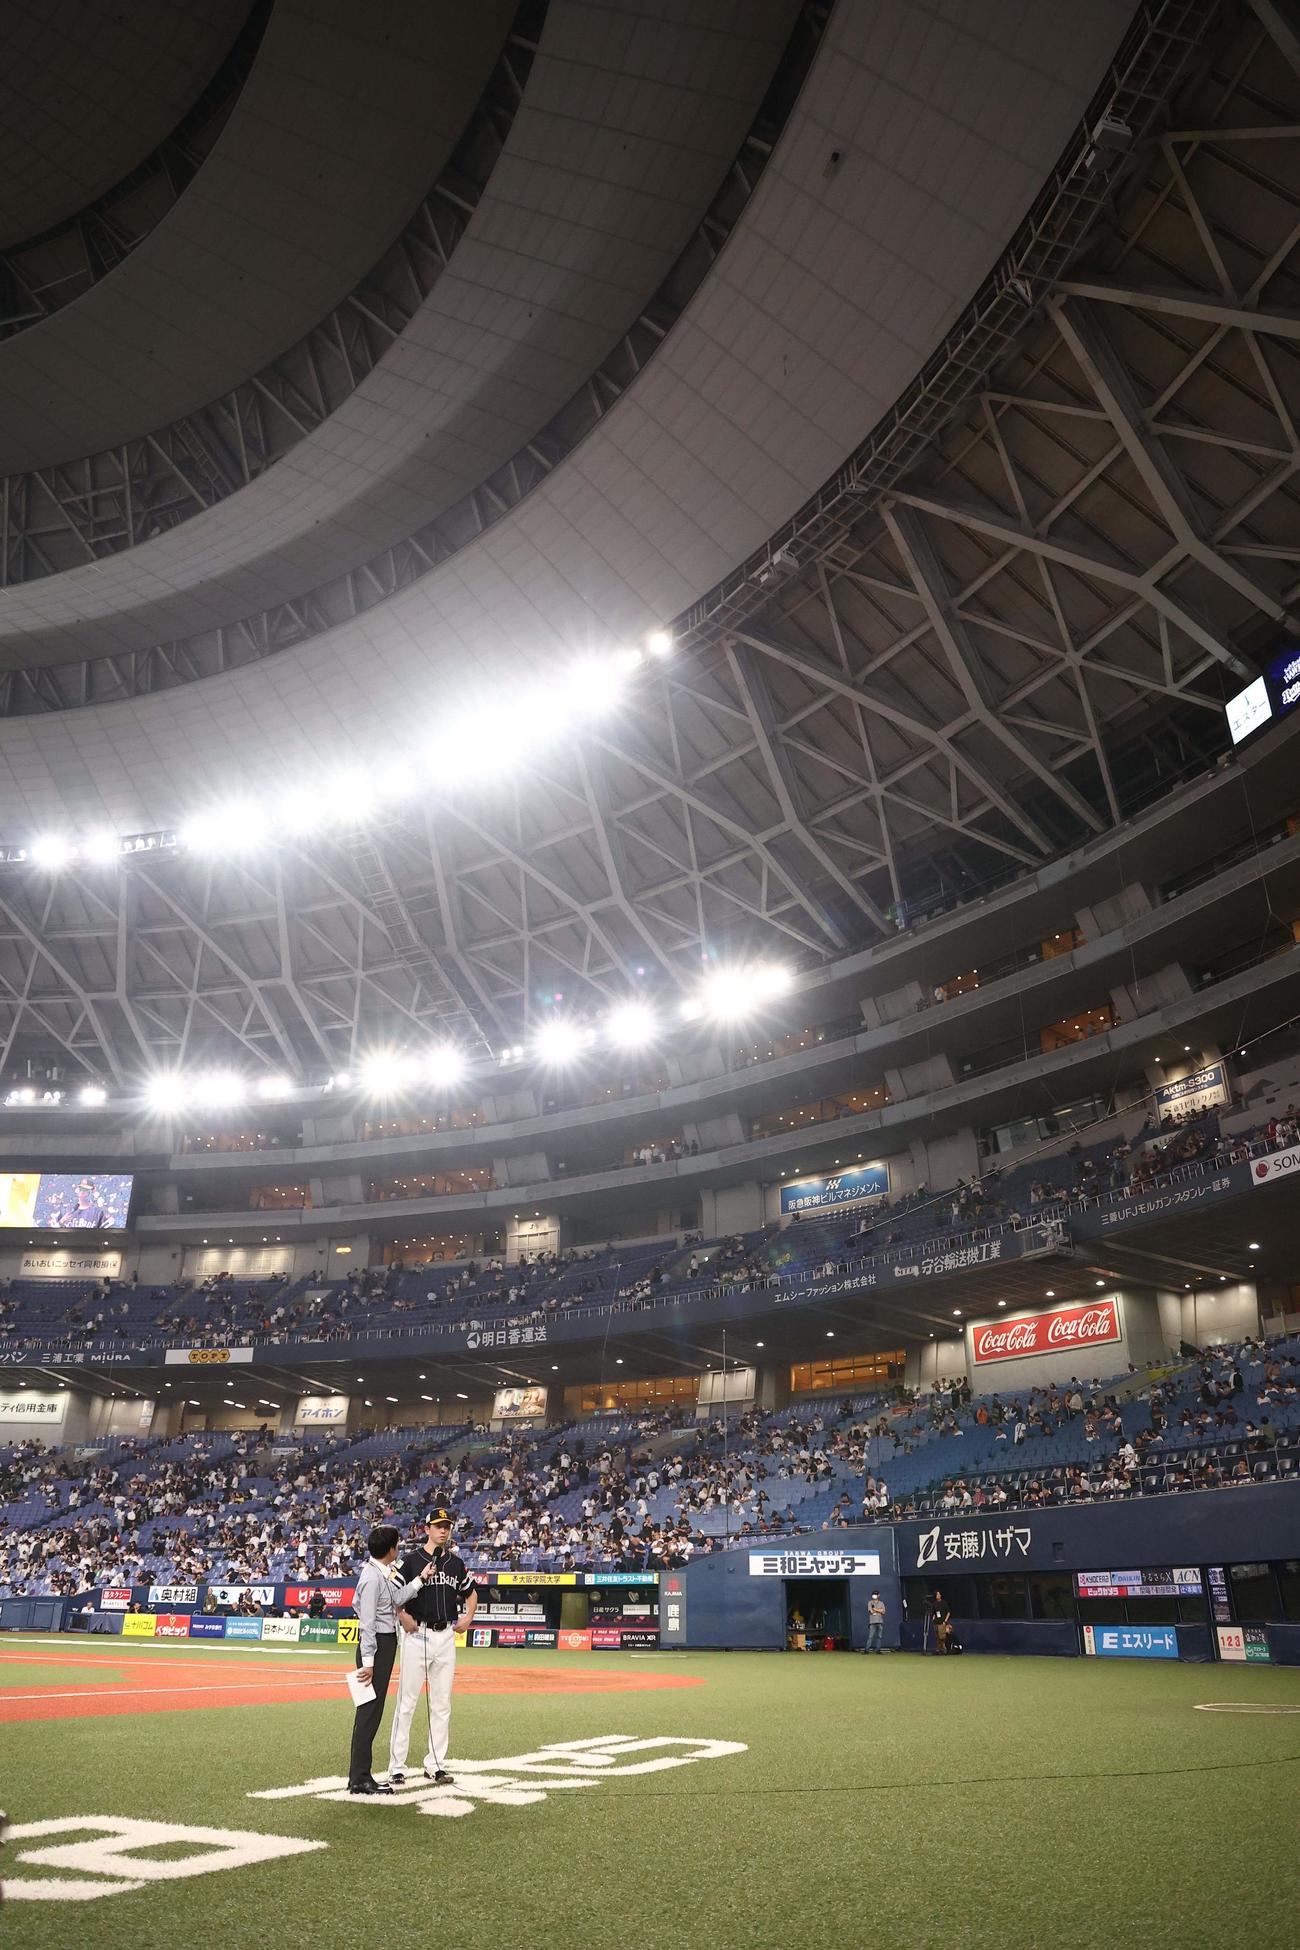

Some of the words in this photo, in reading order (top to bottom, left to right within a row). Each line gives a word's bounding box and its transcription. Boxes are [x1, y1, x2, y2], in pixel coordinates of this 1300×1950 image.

[788, 1182, 880, 1210] 阪急阪神ビルマネジメント
[922, 1241, 1002, 1275] 守谷輸送機工業
[775, 1274, 876, 1302] エムシーファッション株式会社
[482, 1325, 547, 1346] 明日香運送
[41, 1353, 84, 1363] 三浦工業
[301, 1408, 343, 1418] アイホン
[944, 1526, 1031, 1560] 安藤ハザマ
[763, 1557, 866, 1573] 三和シャッター
[519, 1575, 561, 1583] 大阪学院大学
[1177, 1570, 1200, 1582] ACN
[161, 1588, 196, 1601] 奥村組
[667, 1604, 680, 1631] 鹿島
[264, 1625, 296, 1635] 日本トリム
[1122, 1633, 1173, 1650] エスリード
